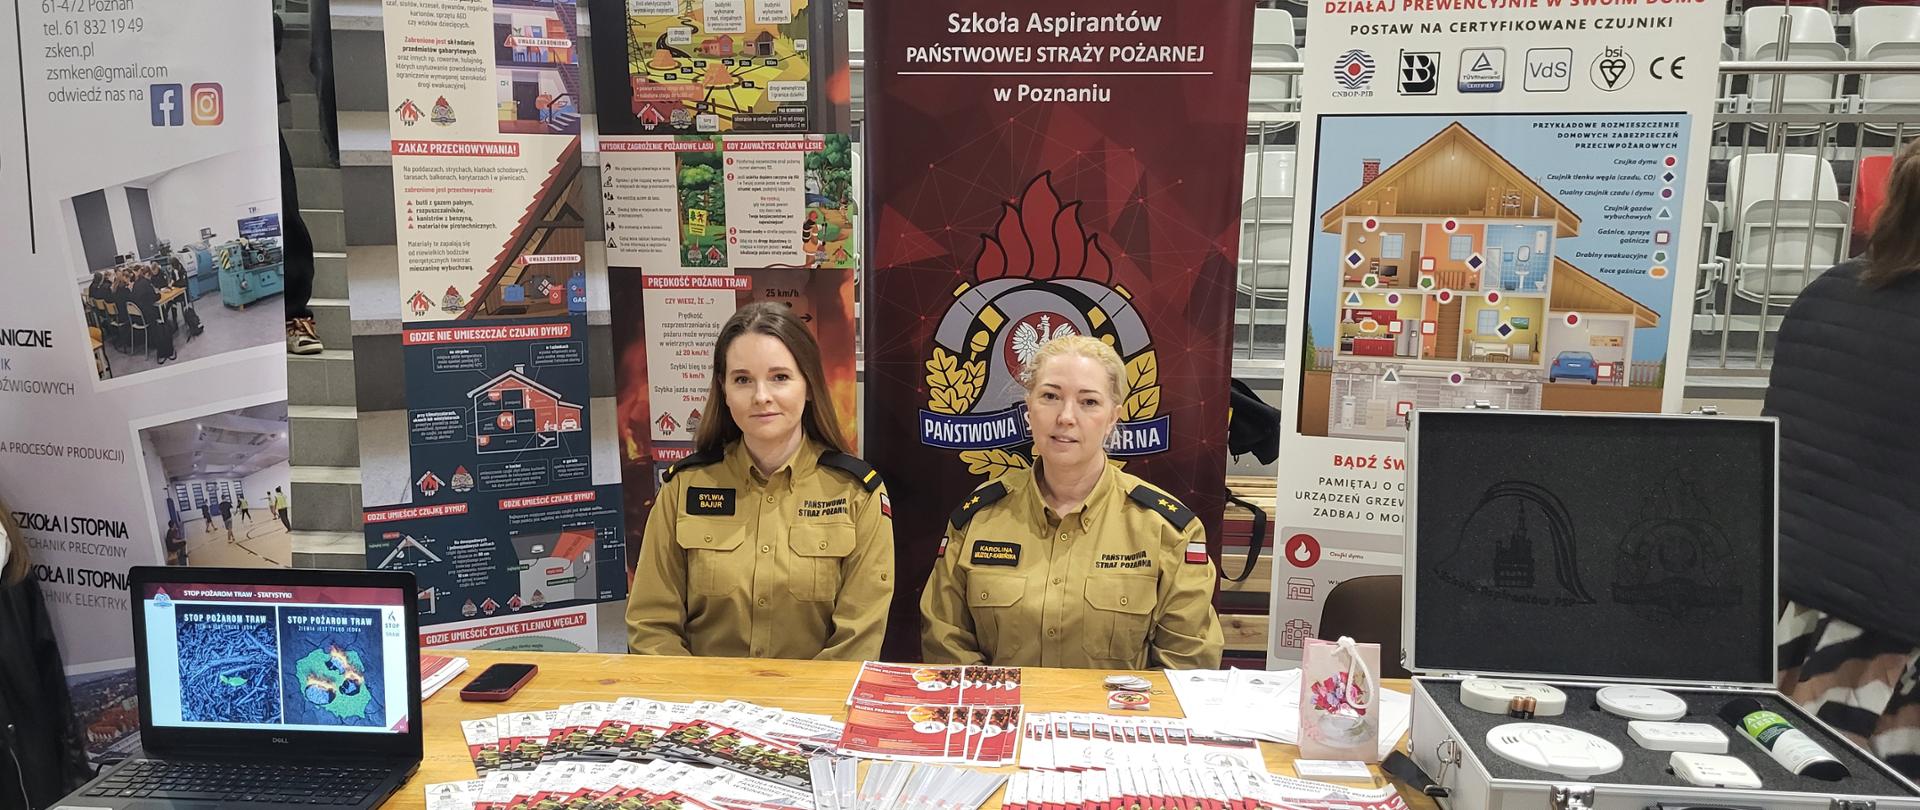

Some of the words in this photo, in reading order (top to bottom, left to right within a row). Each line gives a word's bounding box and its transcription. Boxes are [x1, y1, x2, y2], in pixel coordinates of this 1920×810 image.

[1325, 0, 1396, 14] DZIAŁAJ
[44, 20, 63, 36] tel.
[65, 21, 79, 34] 61
[84, 19, 107, 34] 832
[948, 12, 1019, 33] Szkoła
[1026, 11, 1162, 37] Aspirantów
[1350, 23, 1413, 35] POSTAW
[1420, 23, 1442, 34] NA
[1449, 18, 1587, 33] CERTYFIKOWANE
[1594, 16, 1674, 30] CZUJNIKI
[45, 42, 95, 60] zsken.pl
[906, 43, 1031, 63] PAŃSTWOWEJ
[1037, 43, 1104, 63] STRAŻY
[1109, 43, 1205, 63] POŻARNEJ
[1605, 45, 1623, 59] bsi
[46, 63, 168, 82] zsmken@gmail.com
[1529, 61, 1567, 78] VdS
[1649, 56, 1685, 80] CE
[48, 87, 102, 102] odwiedź
[105, 90, 126, 102] nas
[129, 89, 144, 101] na
[993, 87, 1011, 101] w
[1017, 84, 1111, 102] Poznaniu
[1332, 90, 1374, 98] CNBOP-PIB
[398, 143, 428, 153] ZAKAZ
[430, 144, 517, 155] PRZECHOWYWANIA!
[627, 141, 664, 150] ZAGROŻENIE
[665, 141, 697, 150] POŻAROWE
[727, 142, 738, 150] GDY
[739, 141, 774, 150] ZAUWAŻYSZ
[775, 140, 796, 150] POŻAR
[804, 142, 822, 150] LESIE
[1575, 141, 1677, 149] PRZECIWPOŻAROWYCH
[1613, 158, 1637, 166] Czujka
[1547, 173, 1571, 181] Czujnik
[1620, 236, 1650, 244] gaśnicze
[1575, 251, 1602, 259] Drabiny
[1617, 267, 1646, 275] gaśnicze
[648, 276, 690, 288] PRĘDKOŚĆ
[692, 276, 724, 288] POŻARU
[726, 278, 748, 287] TRAW
[766, 289, 775, 298] 25
[777, 289, 799, 298] km/h
[678, 298, 696, 306] WIESZ,
[698, 297, 704, 305] ŻE
[678, 312, 703, 320] Prędkość
[409, 332, 435, 343] GDZIE
[437, 332, 452, 342] NIE
[454, 328, 508, 341] UMIESZCZAĆ
[509, 328, 539, 339] CZUJKI
[540, 326, 569, 337] DYMU?
[924, 417, 1017, 443] PAŃSTWOWA
[9, 441, 64, 457] PROCESÓW
[1334, 455, 1378, 470] BĄDŹ
[1319, 477, 1378, 490] PAMIĘTAJ
[1383, 481, 1392, 491] O
[503, 499, 521, 508] GDZIE
[522, 496, 553, 507] UMIEŚCIĆ
[699, 493, 724, 501] SYLWIA
[1295, 490, 1360, 504] URZĄDZEŃ
[700, 501, 722, 509] BAJUR
[367, 512, 385, 521] GDZIE
[386, 508, 417, 520] UMIEŚCIĆ
[418, 506, 443, 518] CZUJKĘ
[1313, 508, 1360, 520] ZADBAJ
[1366, 512, 1375, 521] O
[64, 516, 68, 533] I
[71, 517, 129, 539] STOPNIA
[69, 541, 127, 558] PRECYZYJNY
[1329, 551, 1347, 559] Czujki
[67, 568, 74, 584] II
[77, 568, 131, 591] STOPNIA
[201, 588, 233, 598] POŻAROM
[75, 592, 128, 611] ELEKTRYK
[184, 613, 205, 623] STOP
[206, 612, 243, 624] POŻAROM
[245, 614, 267, 624] TRAW
[287, 615, 308, 625] STOP
[309, 614, 348, 626] POŻAROM
[350, 617, 372, 626] TRAW
[426, 632, 449, 645] GDZIE
[451, 626, 487, 643] UMIEŚCIĆ
[488, 623, 519, 637] CZUJKĘ
[521, 619, 551, 633] TLENKU
[553, 614, 584, 629] WĘGLA?
